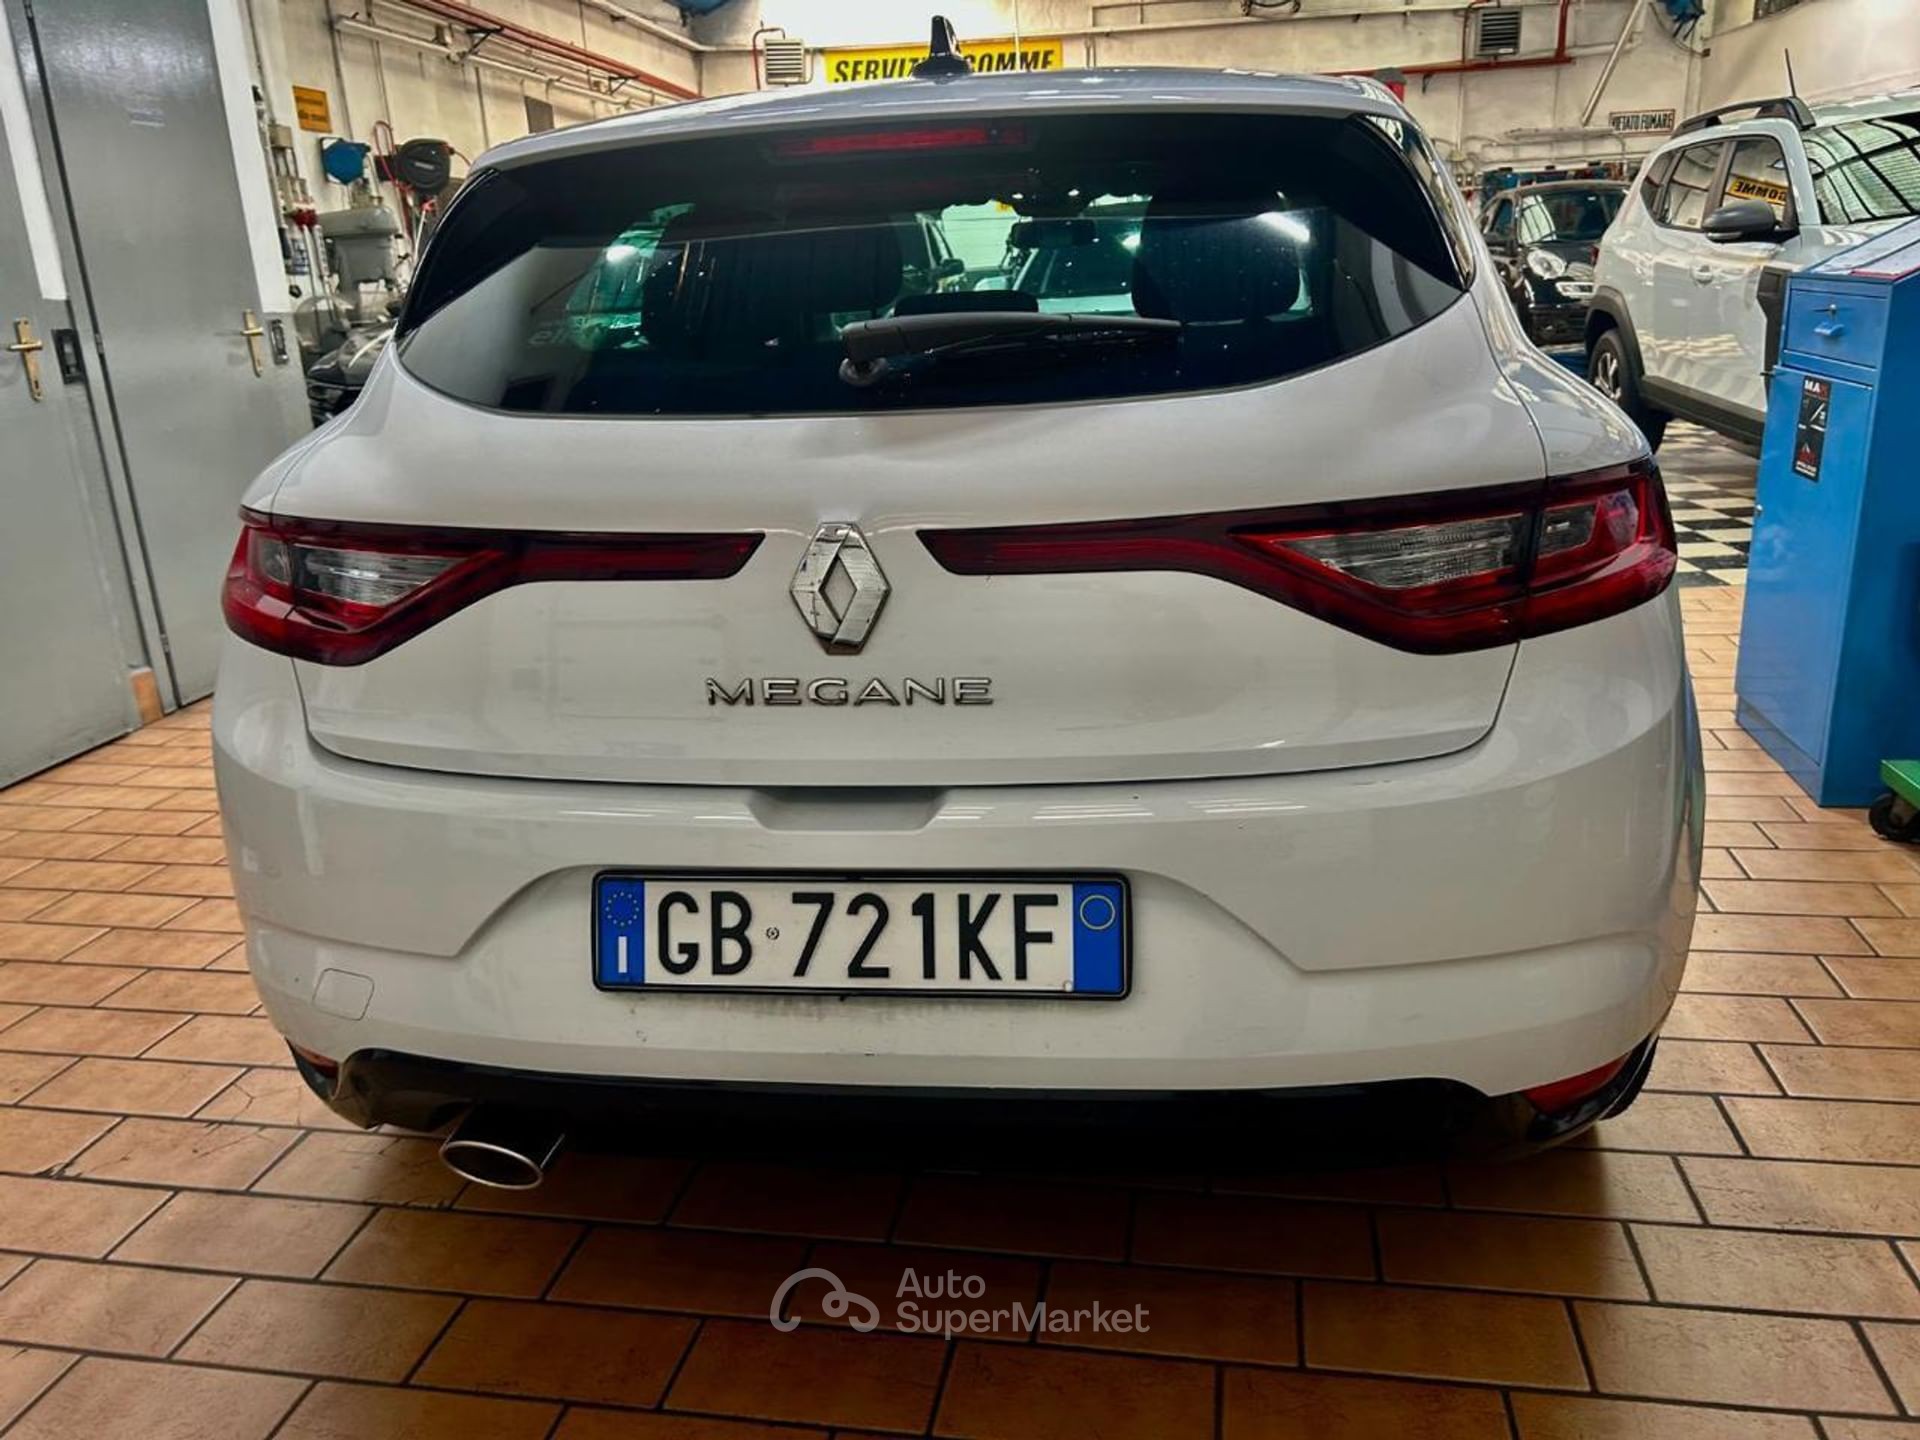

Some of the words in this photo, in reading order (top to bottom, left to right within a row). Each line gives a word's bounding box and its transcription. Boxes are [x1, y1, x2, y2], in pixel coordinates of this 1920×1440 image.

[834, 56, 926, 83] SERVIZ
[705, 676, 995, 707] MEGANE
[656, 890, 753, 976] GB
[791, 891, 1060, 981] 721KF
